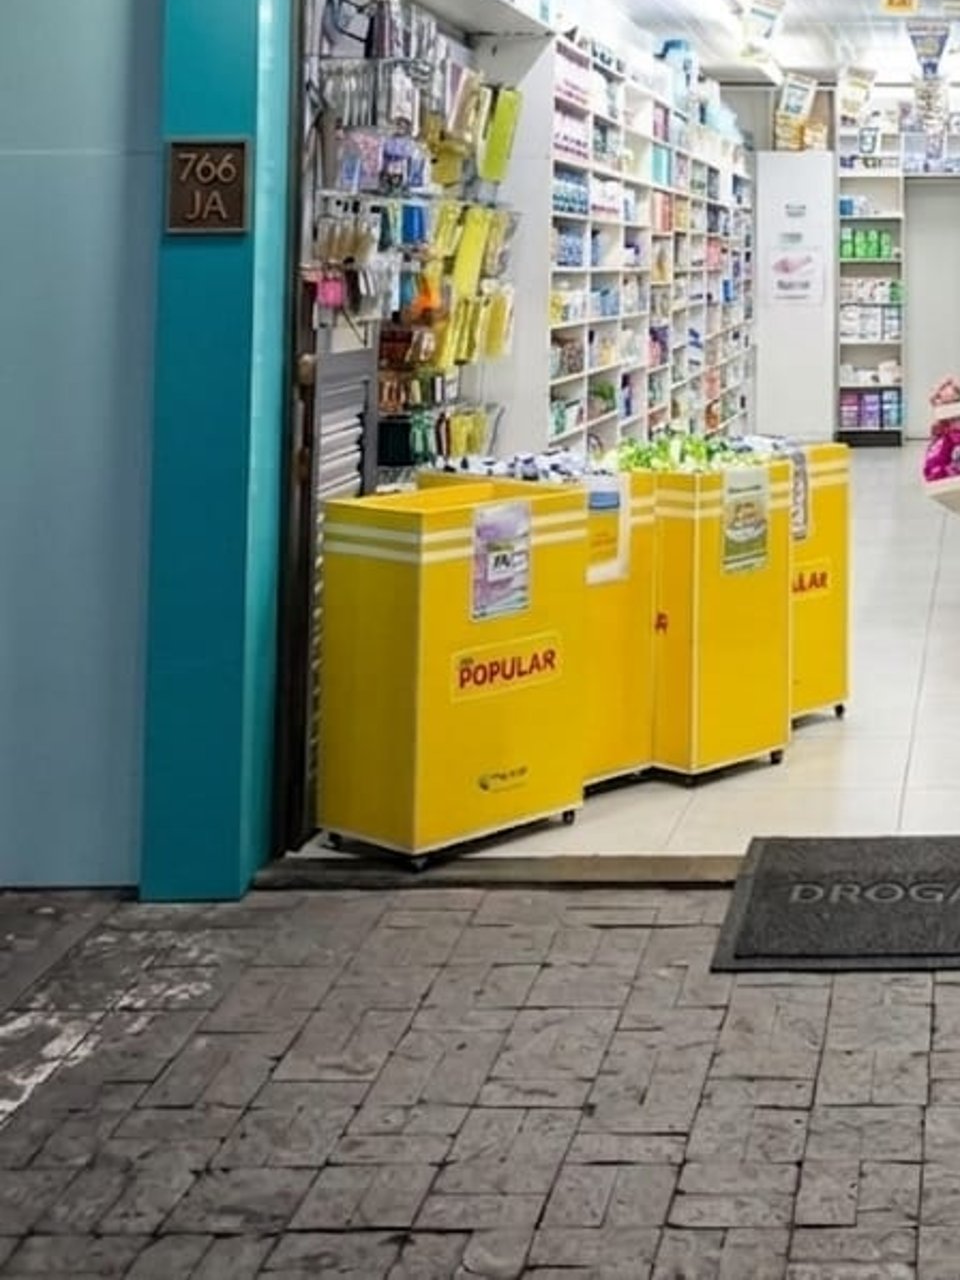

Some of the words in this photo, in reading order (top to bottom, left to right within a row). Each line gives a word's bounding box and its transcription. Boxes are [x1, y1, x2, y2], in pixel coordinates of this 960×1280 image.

[178, 152, 236, 183] 766
[185, 190, 228, 220] JA
[458, 648, 556, 689] POPULAR
